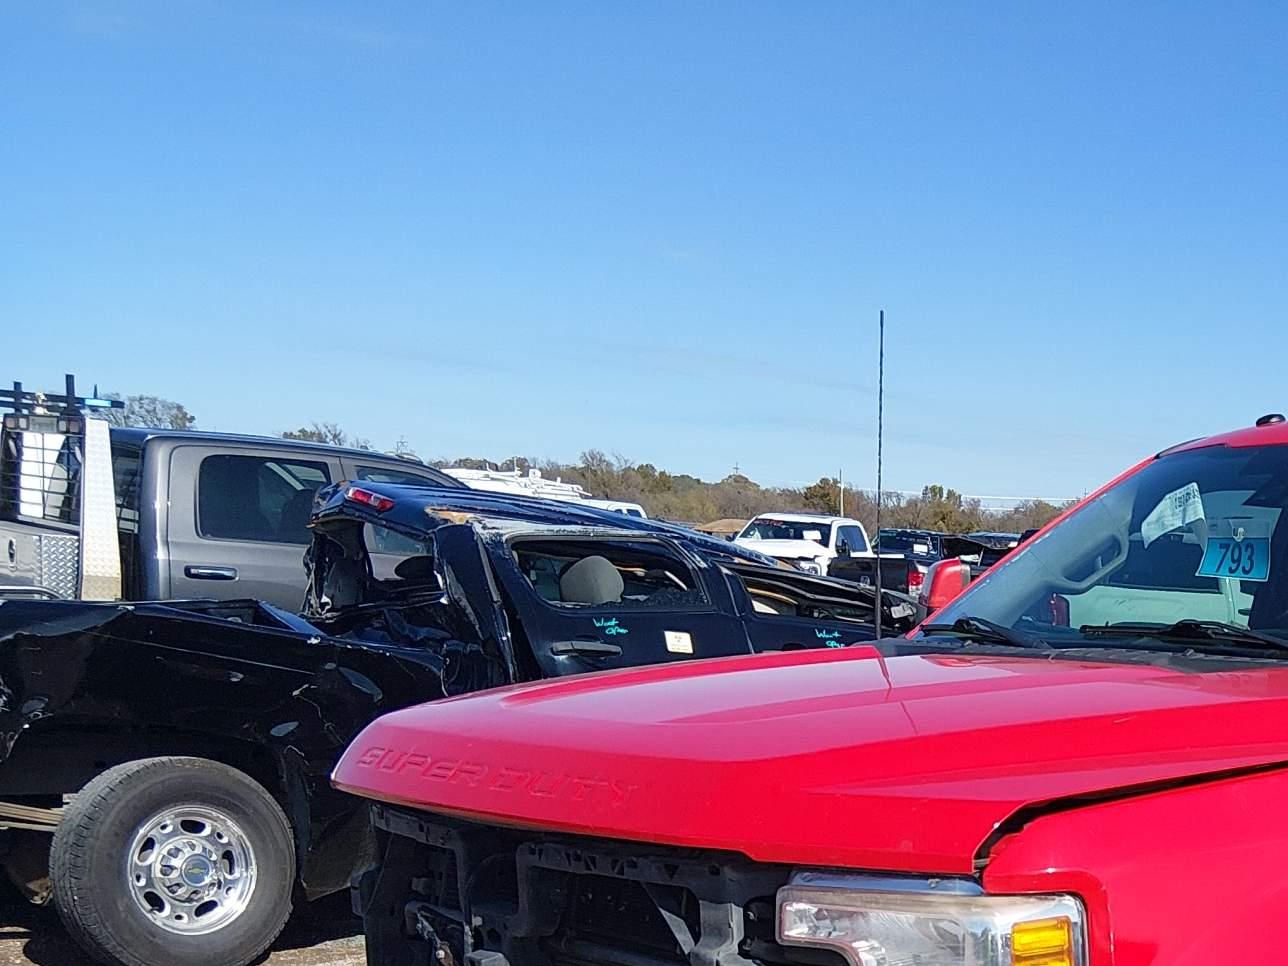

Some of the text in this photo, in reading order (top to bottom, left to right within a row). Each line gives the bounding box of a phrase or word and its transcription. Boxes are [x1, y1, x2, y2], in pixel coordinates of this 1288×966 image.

[1215, 542, 1255, 575] 793
[356, 747, 640, 807] SUPER DUTY
